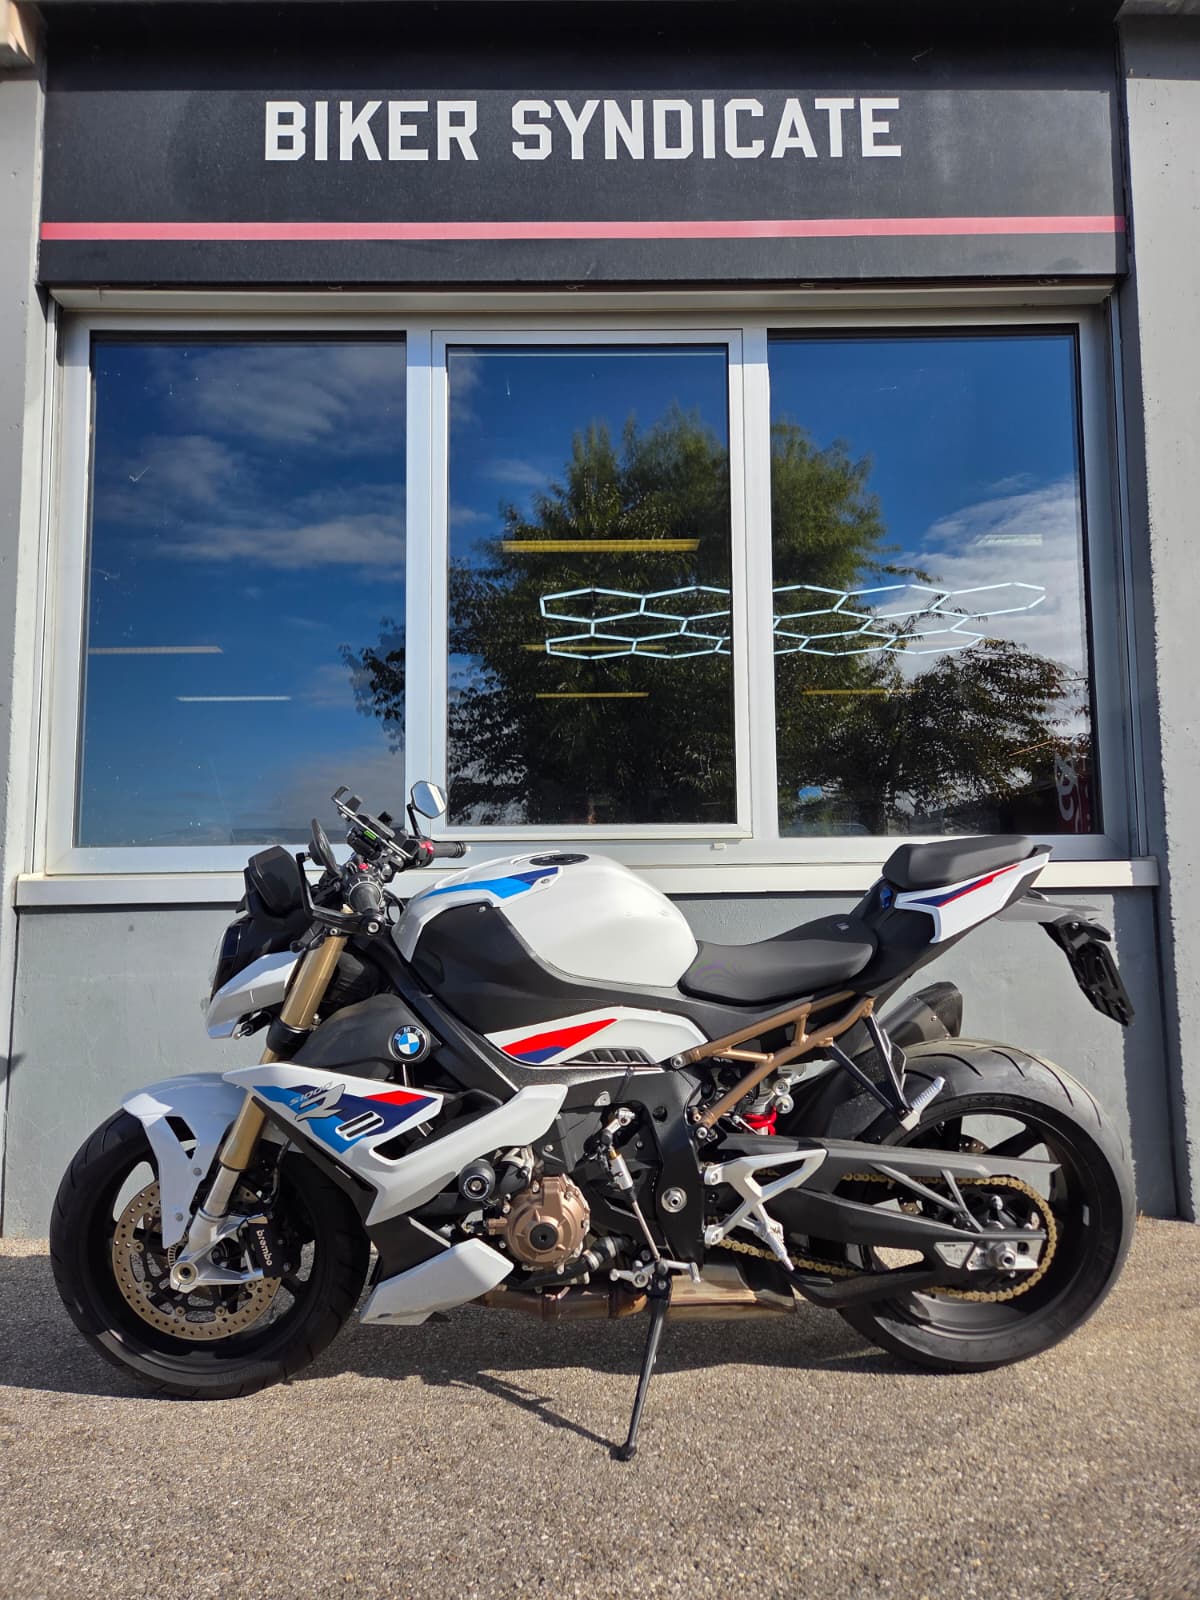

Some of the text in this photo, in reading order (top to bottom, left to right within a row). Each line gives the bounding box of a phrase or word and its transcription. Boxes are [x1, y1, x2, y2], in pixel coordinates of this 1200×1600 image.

[264, 97, 903, 161] BIKER SYNDICATE
[256, 1229, 273, 1266] brembo
